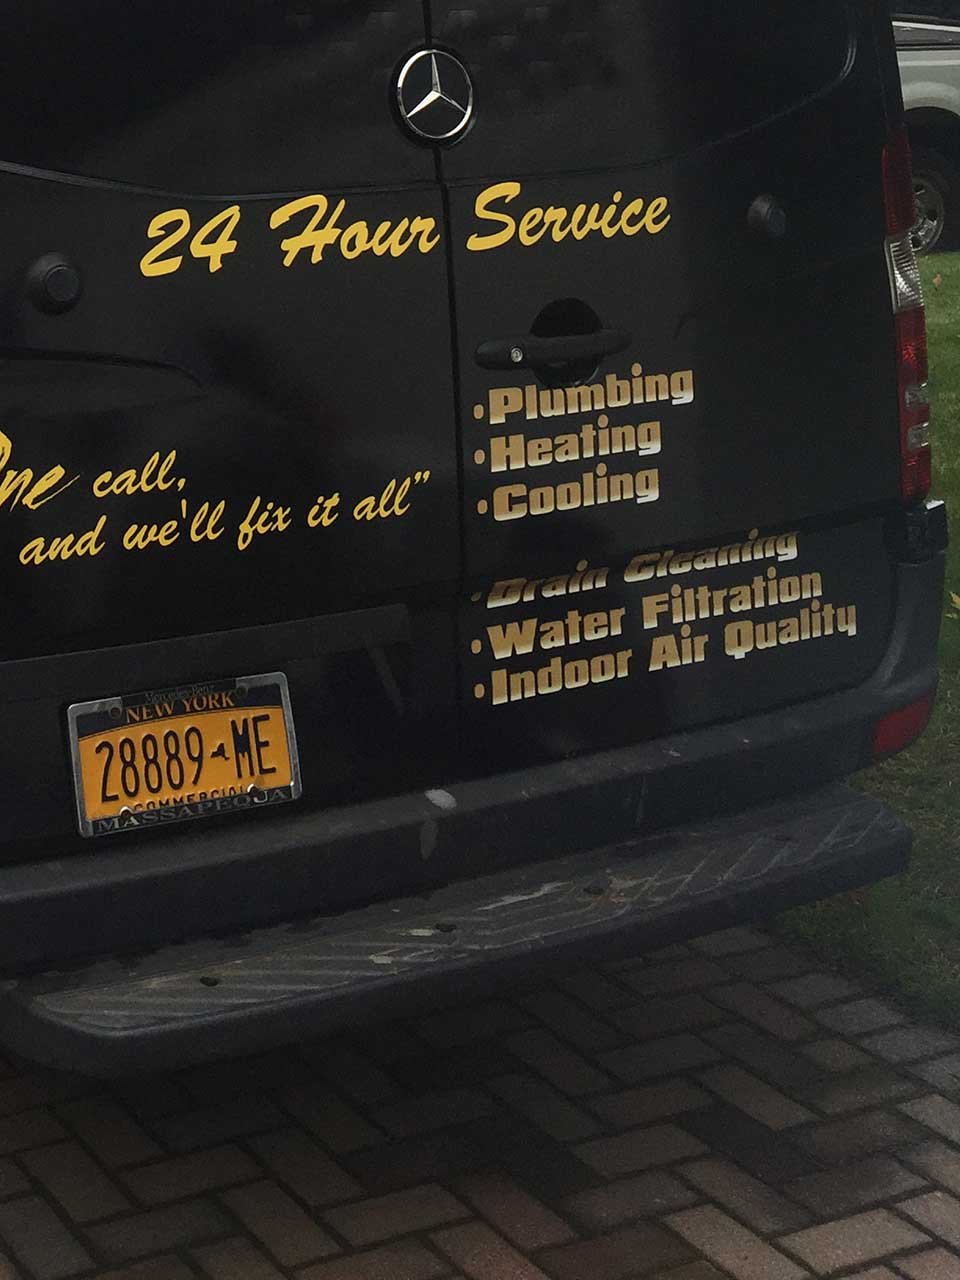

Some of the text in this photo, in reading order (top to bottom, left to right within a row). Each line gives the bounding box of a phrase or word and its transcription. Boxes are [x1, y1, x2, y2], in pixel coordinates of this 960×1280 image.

[139, 181, 671, 278] 24 Hour Service
[488, 362, 695, 424] Plumbing
[92, 449, 186, 499] call,
[490, 414, 662, 473] Heating
[18, 470, 431, 565] and we'll fix it all”
[493, 462, 660, 522] Cooling
[486, 528, 799, 608] Drain Cleaning
[486, 566, 823, 660] Water Filtration
[491, 599, 857, 705] Indoor Air Quality
[126, 691, 235, 724] NEW YORK
[95, 713, 277, 803] 28889 ME
[98, 789, 289, 833] MASSAPEQUA
